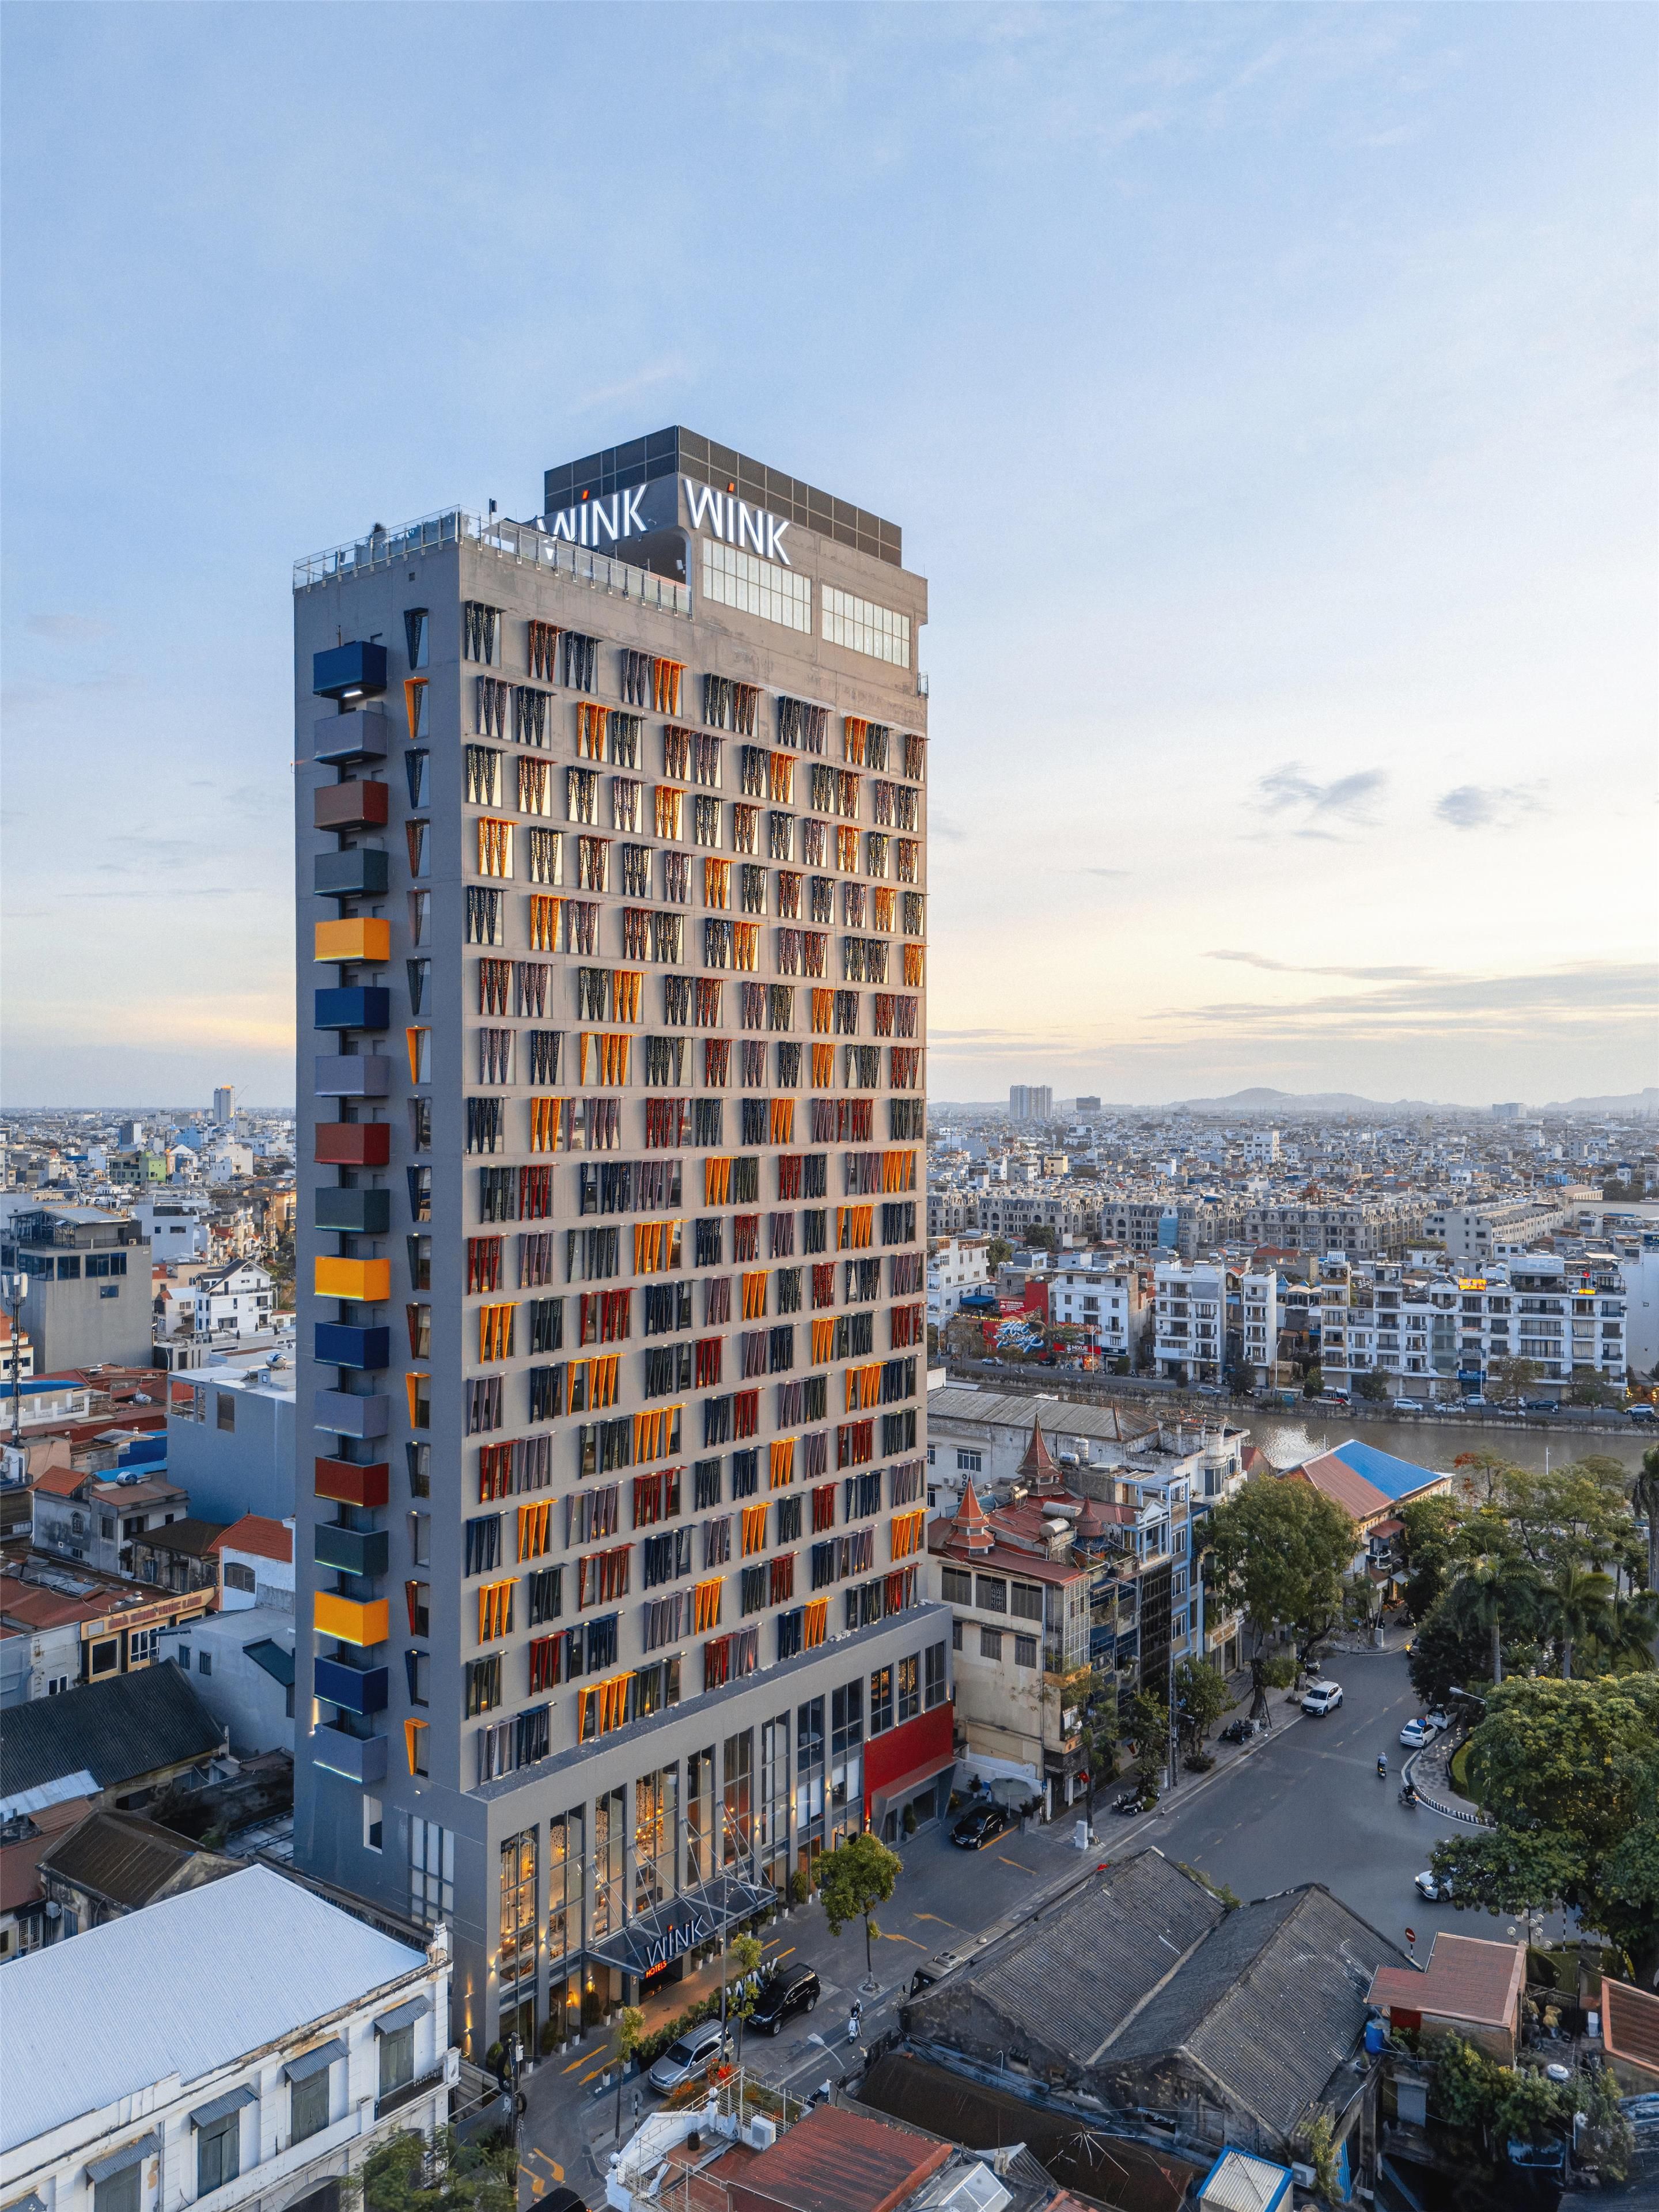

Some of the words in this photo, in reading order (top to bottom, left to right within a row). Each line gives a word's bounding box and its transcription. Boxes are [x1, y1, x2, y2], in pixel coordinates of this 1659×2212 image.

[684, 479, 791, 566] WINK
[646, 1914, 704, 1967] WINK
[645, 1960, 667, 1978] HOTELS
